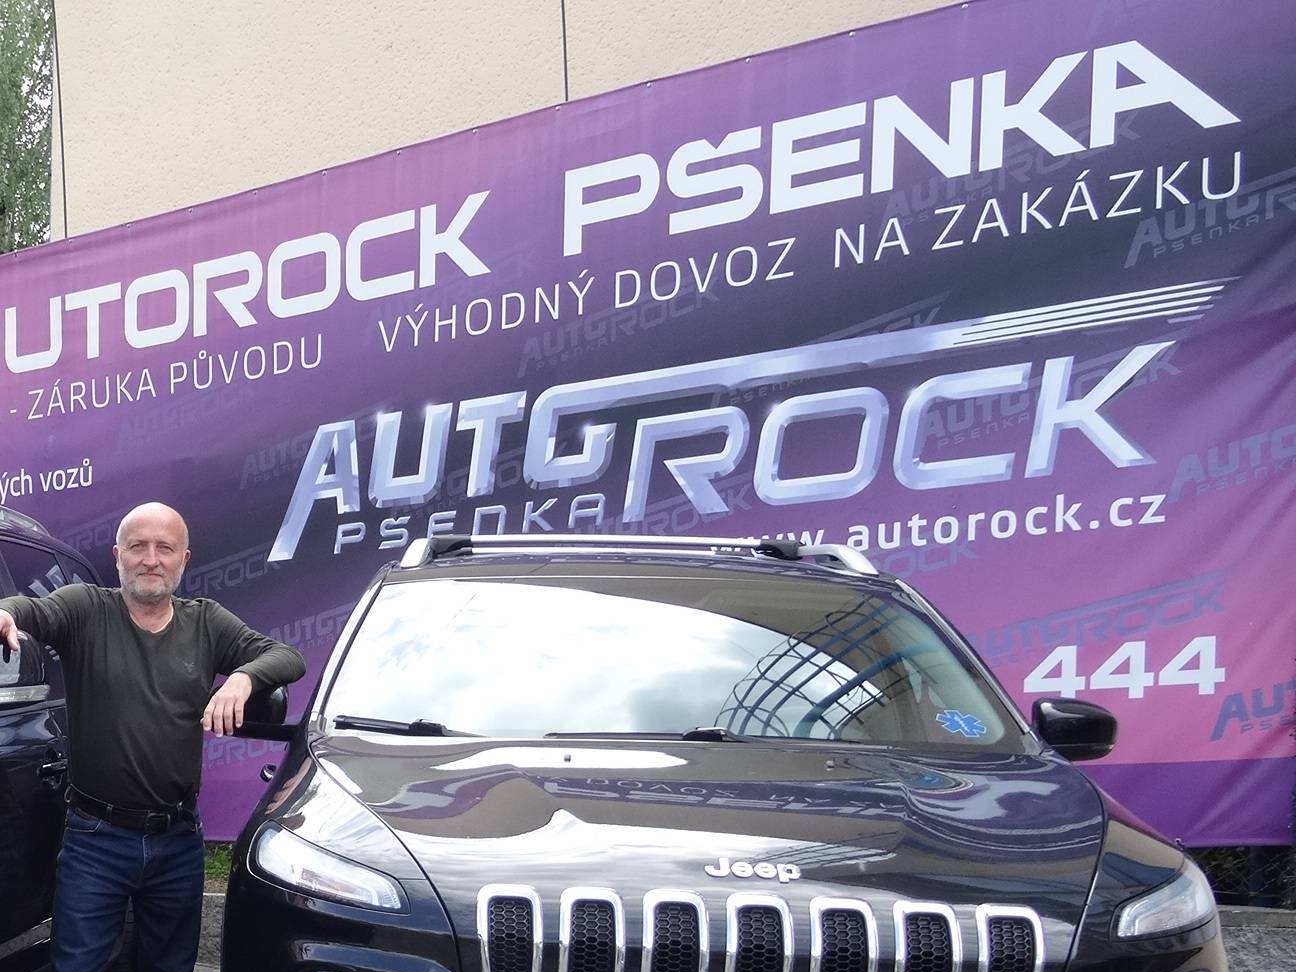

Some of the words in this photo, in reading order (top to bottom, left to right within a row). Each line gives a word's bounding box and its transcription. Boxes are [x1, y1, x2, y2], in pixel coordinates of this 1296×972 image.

[563, 40, 1241, 257] PŠENKA
[27, 368, 156, 420] ZÁRUKA
[170, 333, 322, 394] PŮVODU
[379, 268, 596, 352] VÝHODNÝ
[614, 236, 797, 309] DOVOZ
[834, 217, 910, 269] NA
[931, 151, 1241, 250] ZAKÁZKU
[39, 459, 93, 491] vozů
[267, 320, 1184, 562] AUTOROCK
[1023, 636, 1226, 699] 444
[704, 857, 801, 884] Jeep
